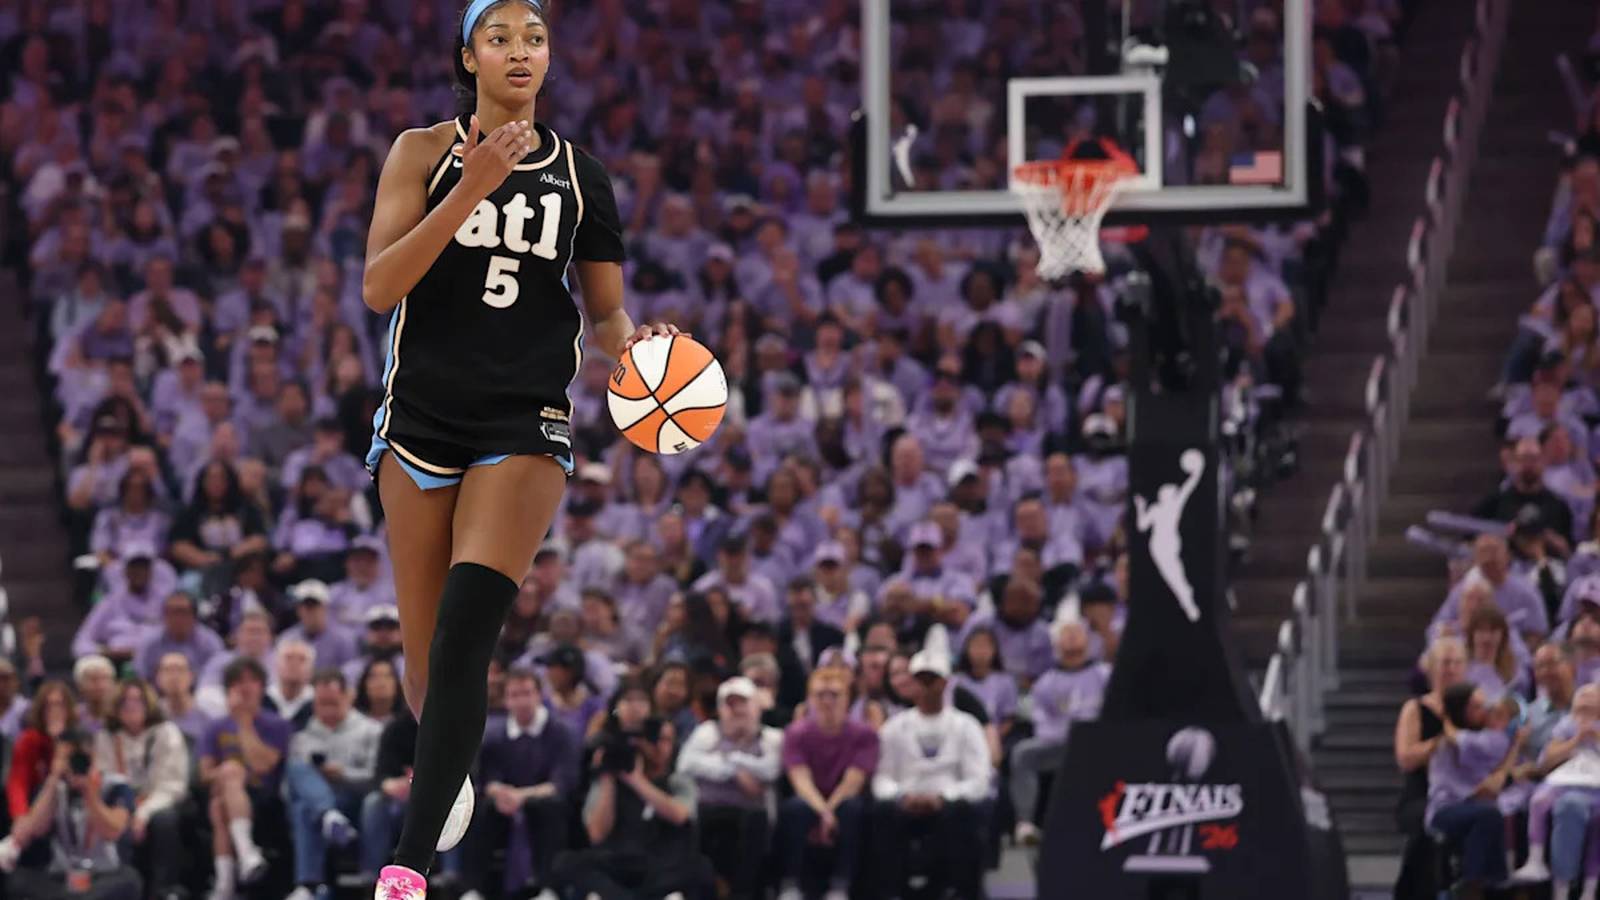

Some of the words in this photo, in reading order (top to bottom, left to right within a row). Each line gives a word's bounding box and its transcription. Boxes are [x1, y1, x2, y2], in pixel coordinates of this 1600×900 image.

[540, 172, 570, 190] Albert
[455, 193, 562, 260] atl
[482, 255, 520, 308] 5
